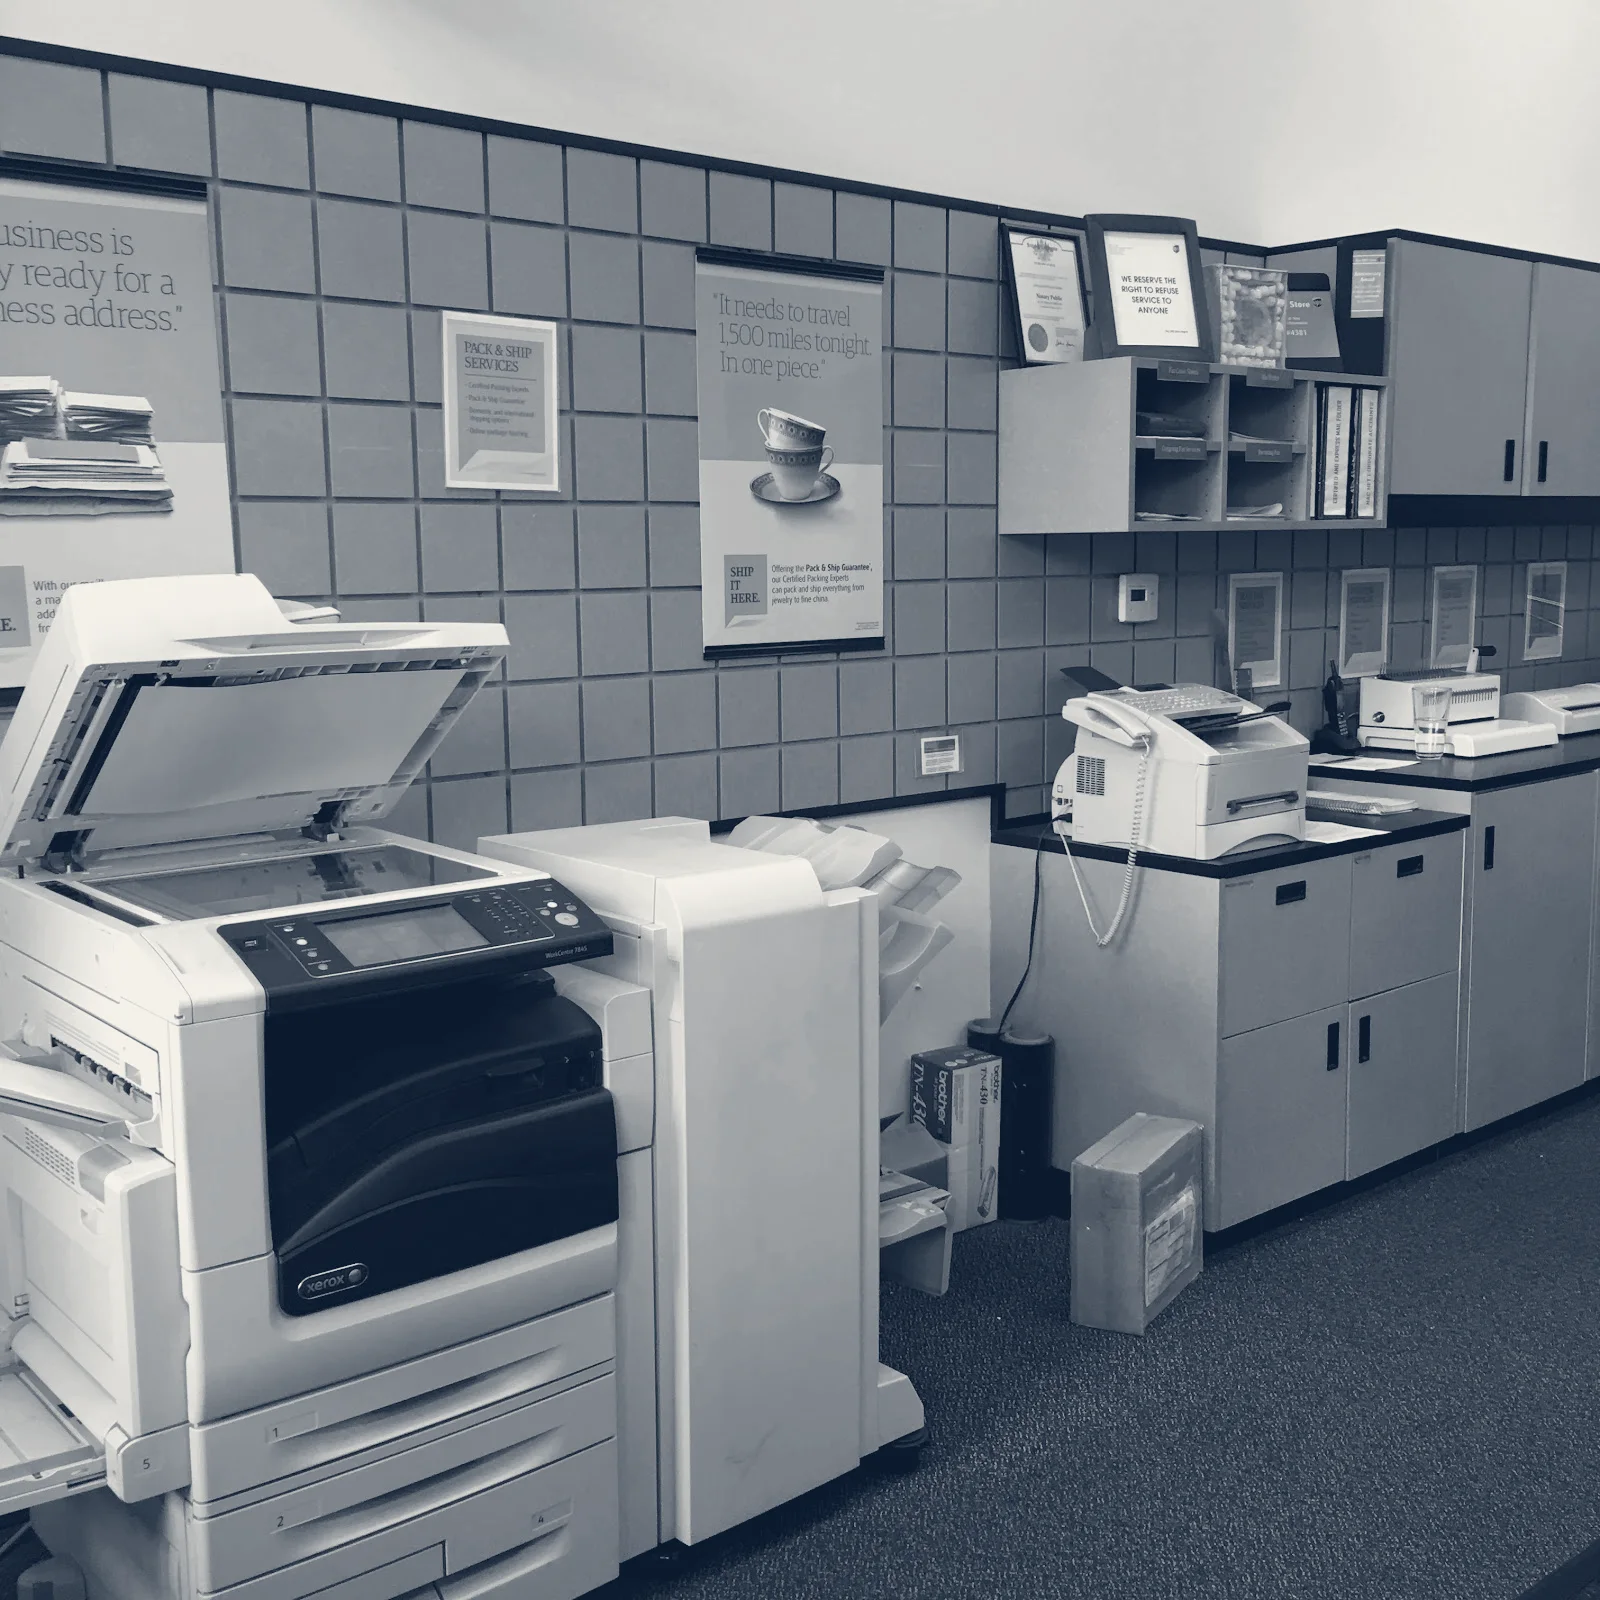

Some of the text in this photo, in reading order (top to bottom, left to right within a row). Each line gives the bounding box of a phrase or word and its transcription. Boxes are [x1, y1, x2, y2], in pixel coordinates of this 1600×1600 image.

[111, 227, 134, 256] is
[23, 260, 106, 297] ready
[114, 263, 151, 294] for
[160, 274, 176, 295] a
[1121, 275, 1177, 285] WE RESERVE THE
[1144, 286, 1154, 294] TO
[1155, 287, 1179, 295] REFUSE
[1131, 296, 1172, 305] SERVICE TO
[1290, 300, 1311, 308] Store
[64, 298, 183, 332] address."
[735, 297, 784, 321] needs
[788, 302, 804, 323] to
[808, 304, 851, 327] travel
[1138, 306, 1169, 315] ANYONE
[718, 321, 872, 360] 1,500 miles tonight.
[464, 340, 532, 359] PACK & SHIP
[464, 356, 519, 373] SERVICES
[720, 350, 738, 373] In
[742, 357, 773, 376] one
[730, 566, 754, 578] SHIP
[771, 564, 795, 574] Offering
[795, 564, 805, 572] the
[805, 564, 820, 572] Pack
[821, 563, 826, 571] &
[827, 563, 841, 573] Ship
[783, 574, 806, 583] Certified
[807, 574, 829, 584] Packing
[830, 574, 850, 583] Experts
[33, 580, 58, 591] With
[730, 580, 741, 591] IT
[784, 586, 797, 595] pack
[798, 585, 809, 593] and
[810, 585, 822, 594] ship
[823, 584, 852, 594] everything
[852, 583, 865, 592] from
[35, 597, 42, 606] a
[730, 592, 761, 604] HERE.
[771, 597, 793, 606] jewelry
[794, 596, 800, 604] to
[801, 595, 812, 603] fine
[980, 1066, 988, 1105] TN-430
[937, 1070, 948, 1125] brother
[306, 1274, 345, 1294] xerox
[272, 1427, 278, 1438] 1
[143, 1458, 150, 1470] 5
[276, 1515, 284, 1528] 2
